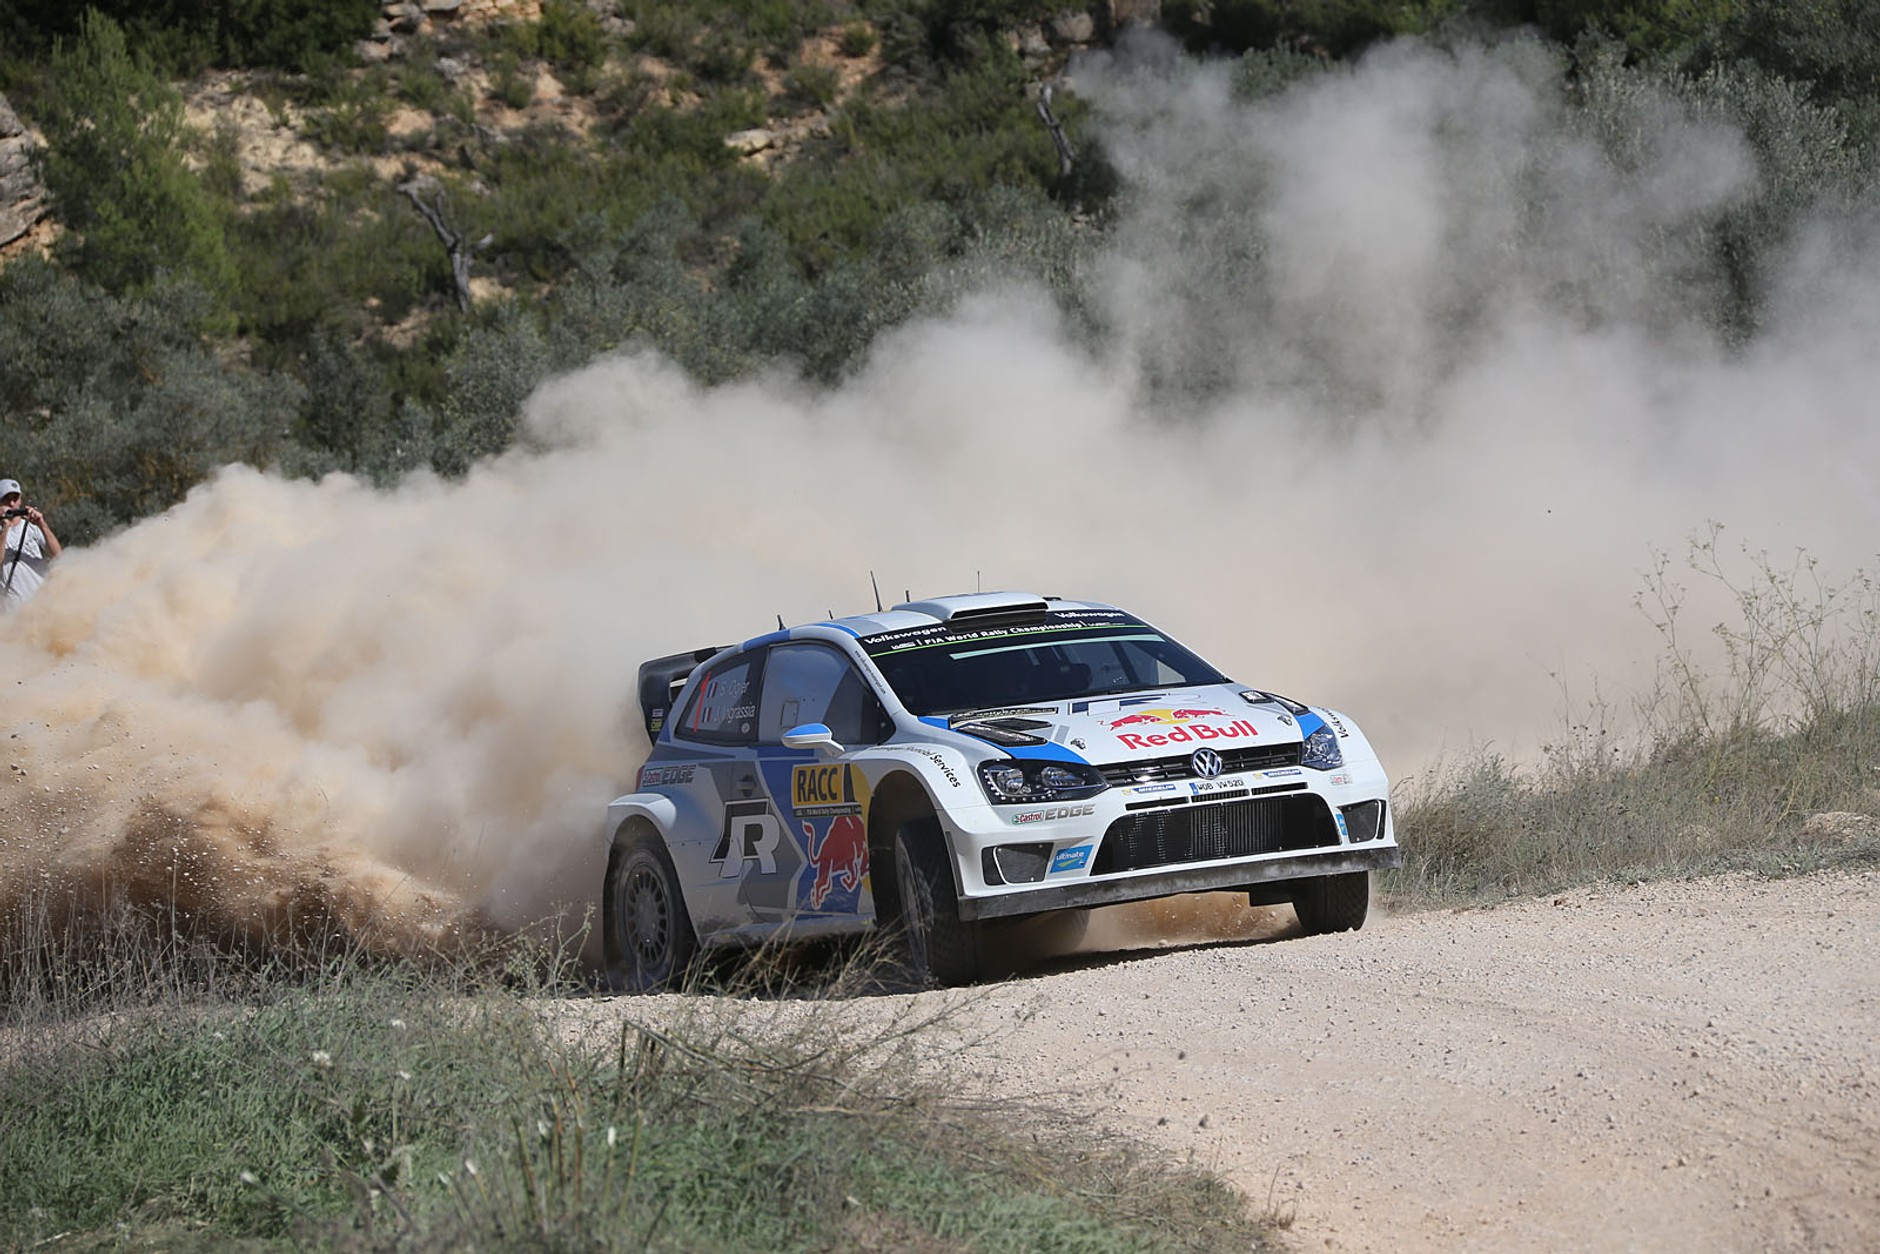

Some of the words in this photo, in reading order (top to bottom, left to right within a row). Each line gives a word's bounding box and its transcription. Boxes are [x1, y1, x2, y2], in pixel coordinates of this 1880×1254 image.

[864, 626, 947, 645] Volkswagen
[925, 638, 944, 646] FIA
[945, 631, 978, 642] World
[980, 629, 1008, 638] Rally
[1009, 622, 1082, 634] Championship
[1116, 726, 1194, 750] Red
[1188, 719, 1259, 740] Bull
[661, 764, 697, 784] EDGE
[930, 754, 961, 788] Services
[797, 767, 838, 802] RACC
[1019, 812, 1042, 823] Castrol
[1045, 804, 1096, 821] EDGE
[1056, 851, 1085, 861] ultimate
